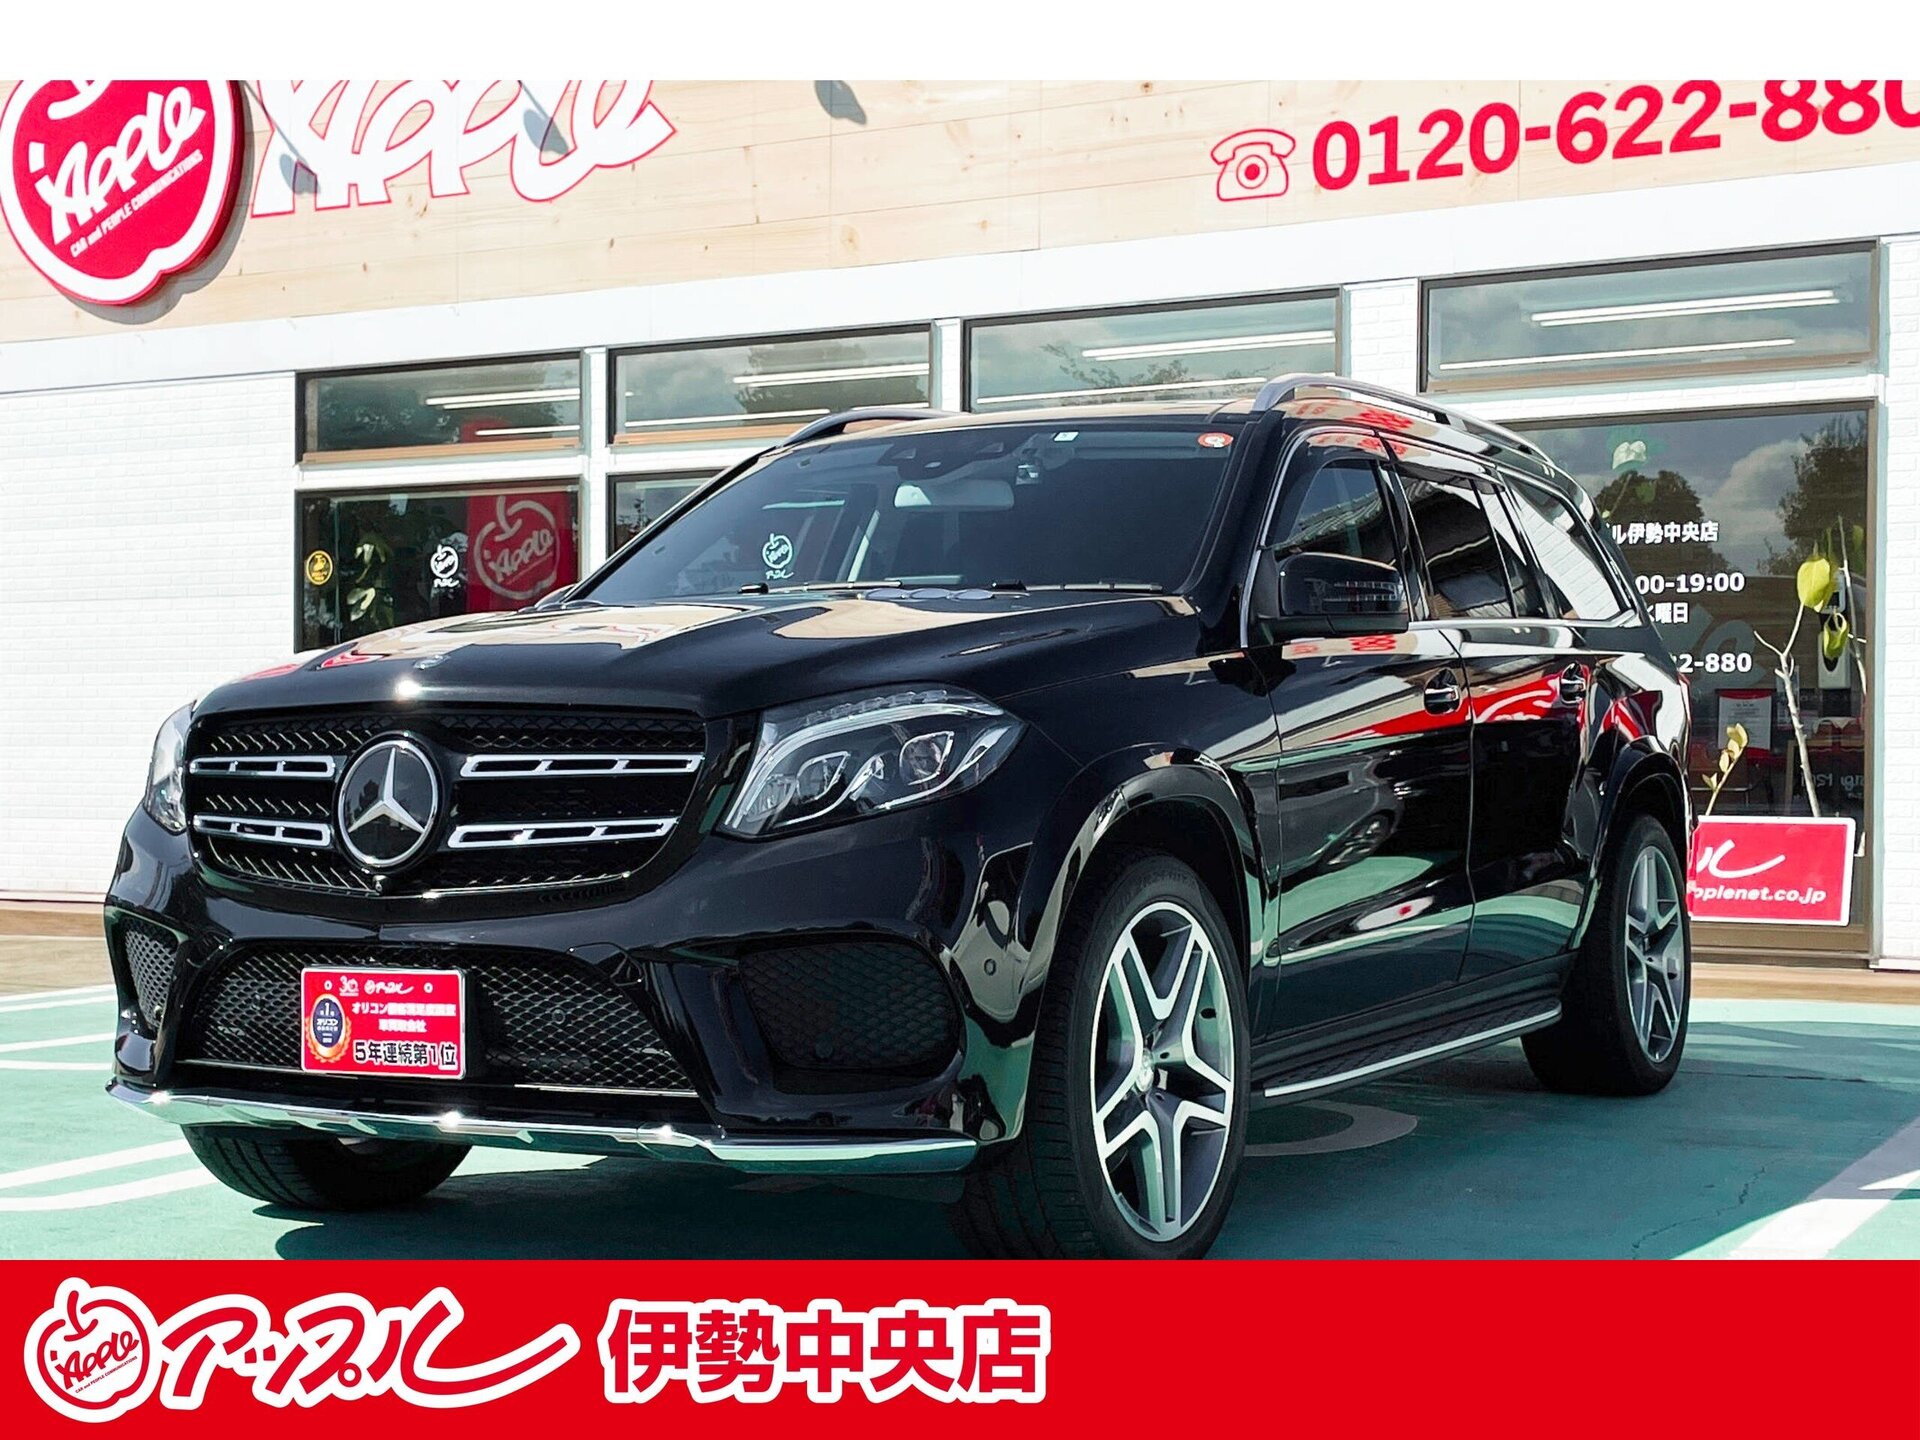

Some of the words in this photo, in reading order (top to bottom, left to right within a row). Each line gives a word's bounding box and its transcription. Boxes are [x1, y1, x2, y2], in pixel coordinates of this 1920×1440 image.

[101, 202, 133, 235] PEOPLE
[1606, 520, 1719, 544] ル伊勢中央店
[1673, 652, 1752, 674] 2-880
[354, 1041, 457, 1066] 5年連続第1位
